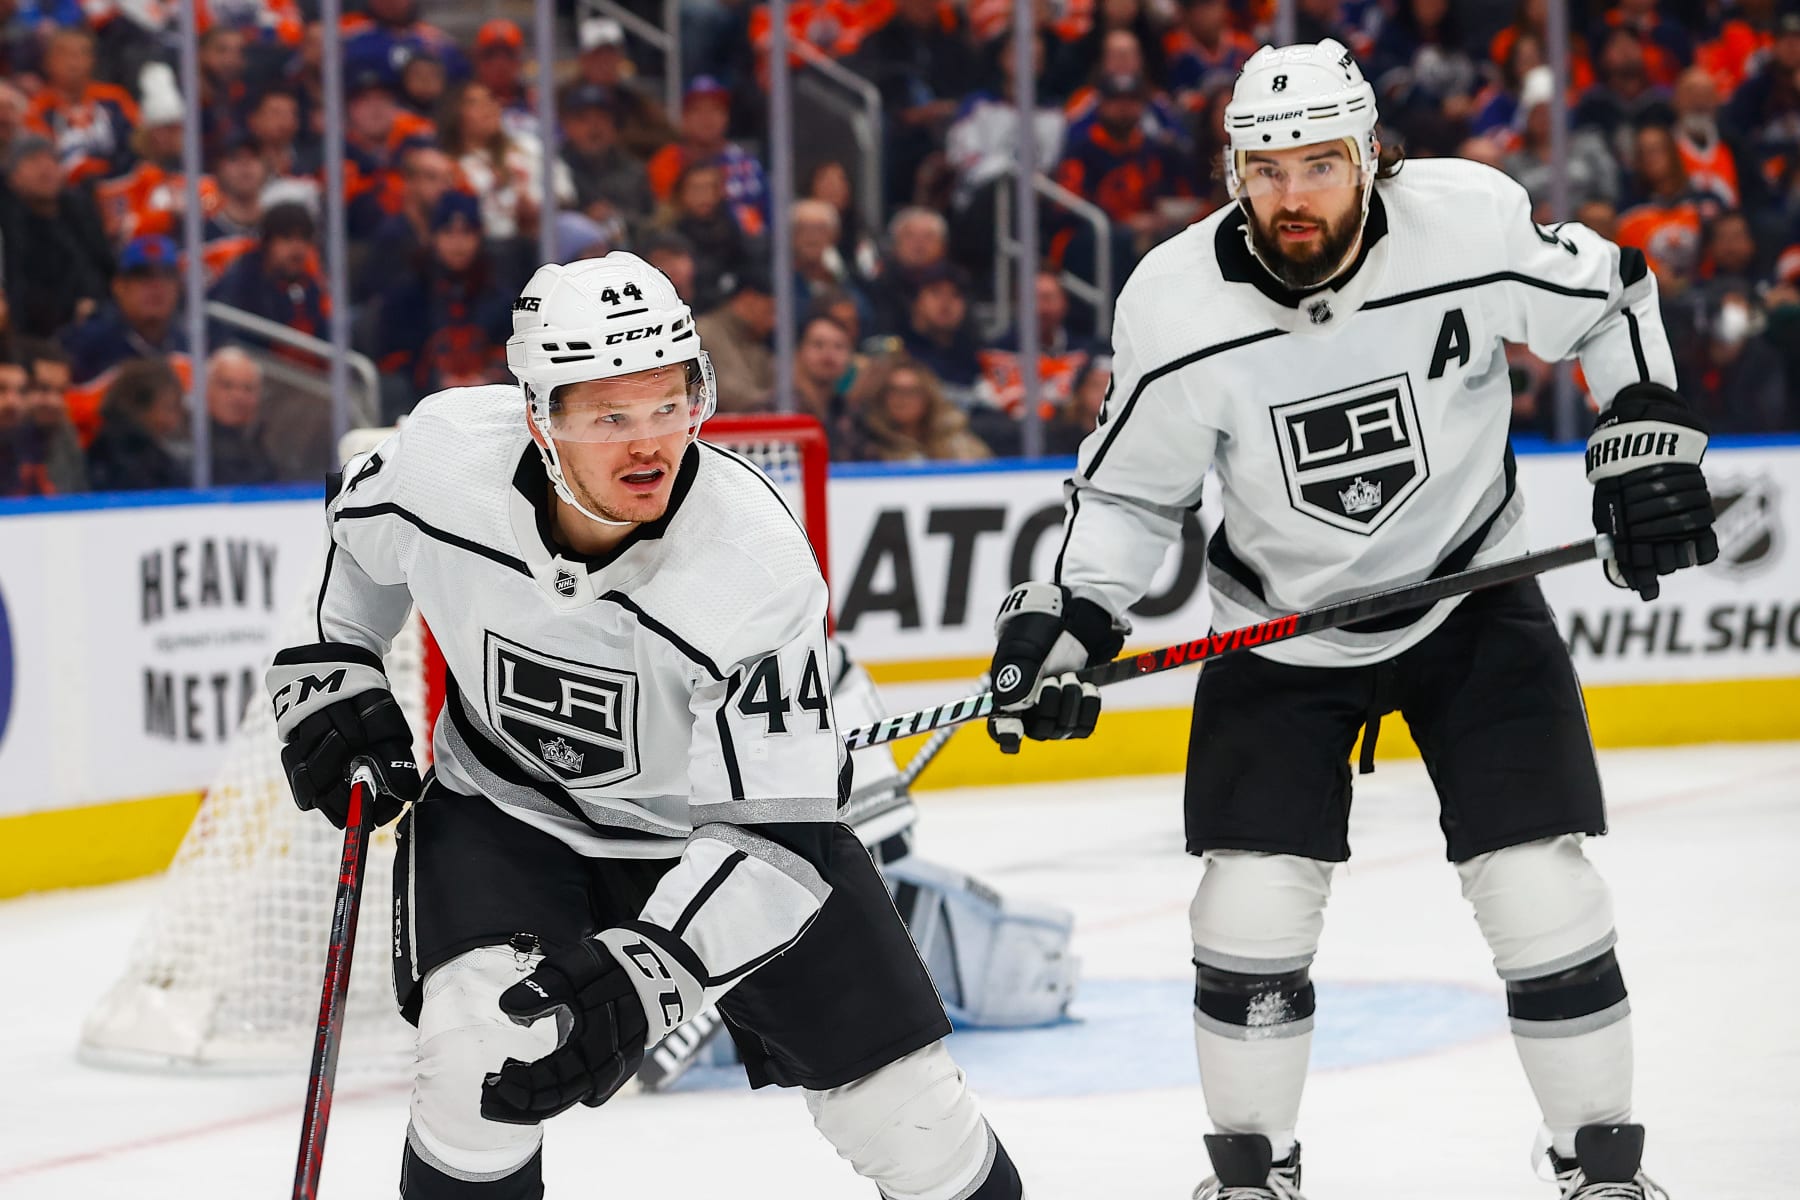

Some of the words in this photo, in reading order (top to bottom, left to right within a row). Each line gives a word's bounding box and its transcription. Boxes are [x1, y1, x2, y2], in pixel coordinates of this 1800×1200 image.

[1272, 74, 1288, 92] 8
[1256, 110, 1303, 123] BAUER
[601, 282, 643, 306] 44
[605, 324, 663, 345] CCM
[1427, 307, 1470, 380] A
[1291, 396, 1407, 465] LA
[140, 537, 279, 624] HEAVY
[557, 578, 575, 590] NHL
[1161, 613, 1299, 669] NOVIUM
[501, 657, 619, 732] LA
[734, 647, 832, 737] 44
